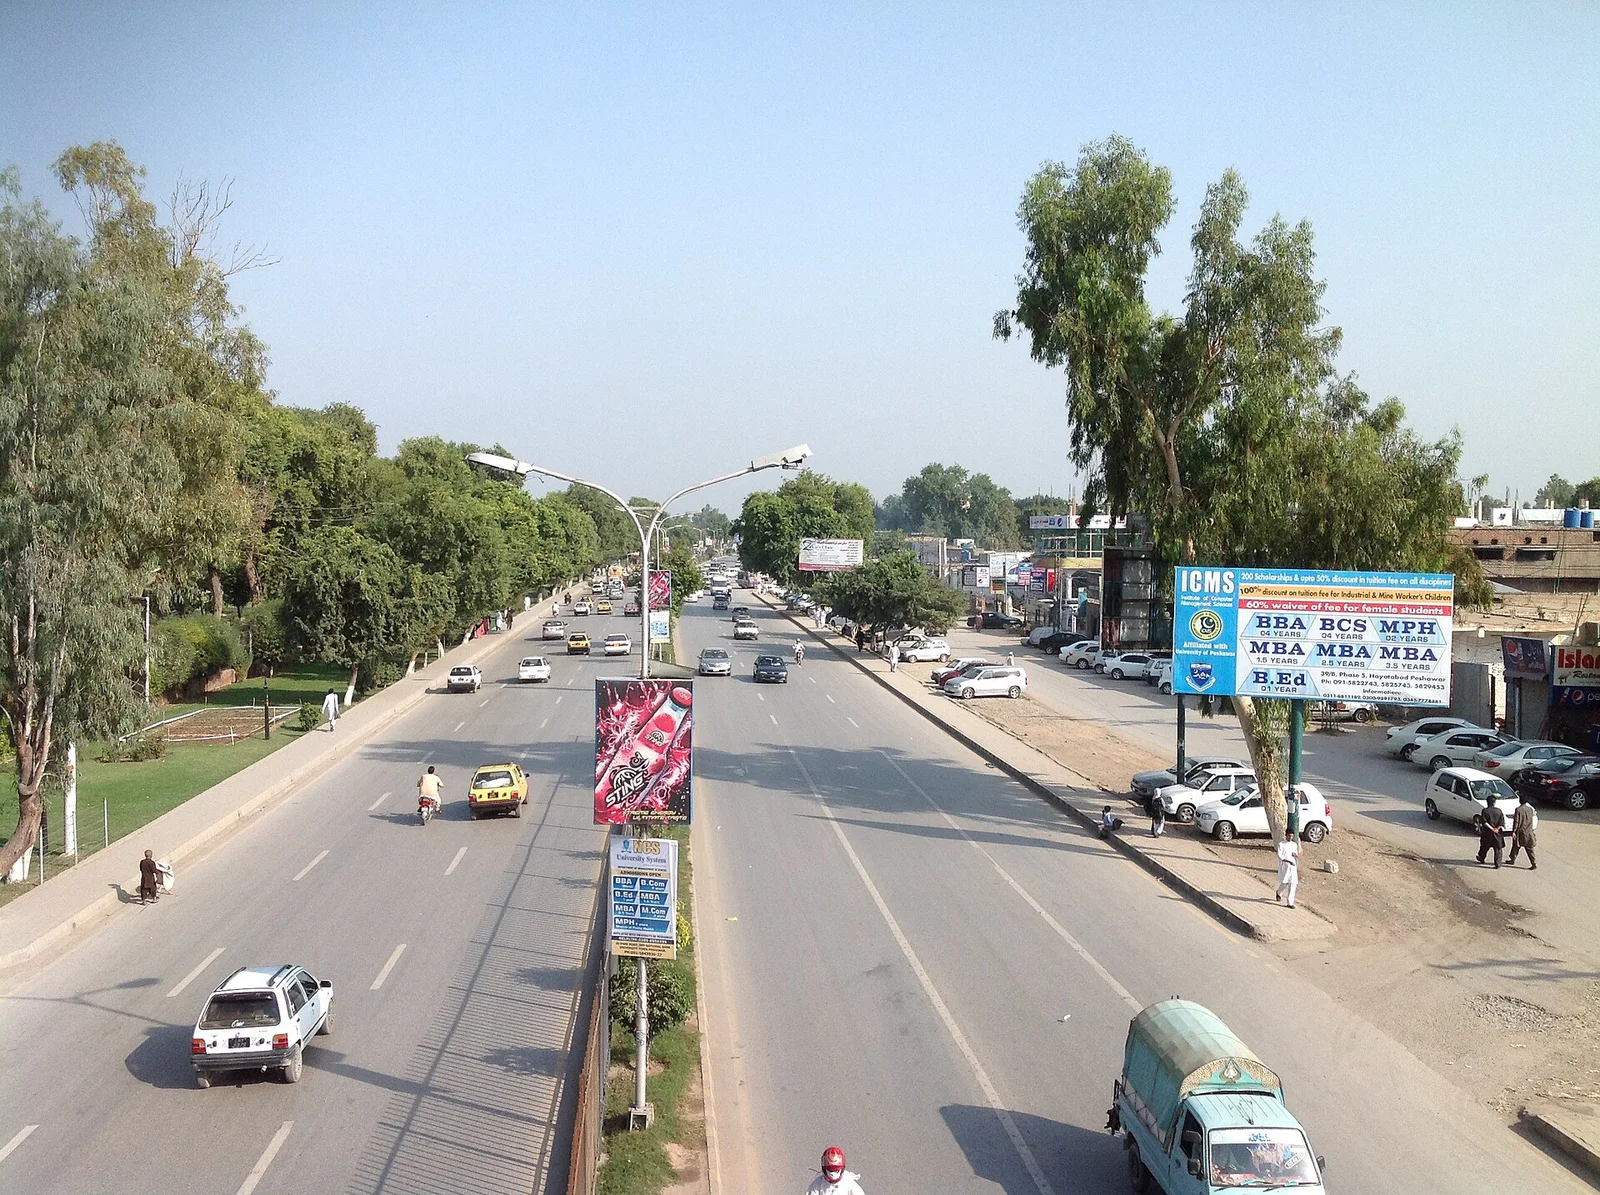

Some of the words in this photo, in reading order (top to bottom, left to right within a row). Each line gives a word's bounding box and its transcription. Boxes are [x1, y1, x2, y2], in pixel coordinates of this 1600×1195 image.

[1181, 569, 1235, 594] ICMS
[1241, 572, 1254, 580] 200
[1254, 572, 1293, 583] Scholarships
[1331, 575, 1358, 583] discount
[1410, 577, 1418, 585] all
[1419, 578, 1451, 587] disciplines
[1240, 586, 1261, 595] 100%
[1262, 588, 1288, 596] discount
[1298, 589, 1317, 597] tuition
[1341, 590, 1370, 599] Industrial
[1378, 592, 1393, 600] Mine
[1395, 593, 1423, 601] Worker's
[1425, 593, 1451, 601] Children
[1246, 601, 1269, 609] 60%
[1272, 602, 1308, 610] waiver
[1311, 603, 1322, 611] of
[1324, 603, 1341, 611] fee
[1344, 604, 1359, 612] for
[1362, 605, 1398, 614] female
[1401, 606, 1444, 615] students
[1256, 615, 1307, 630] BBA
[1319, 617, 1367, 633] BCS
[1379, 620, 1436, 635] MPH
[1335, 633, 1363, 641] YEARS
[1399, 635, 1429, 643] YEARS
[1183, 642, 1213, 650] Affiliated
[1249, 641, 1306, 656] MBA
[1316, 643, 1372, 659] MBA
[1175, 648, 1202, 657] University
[1379, 646, 1438, 662] MBA
[1270, 657, 1299, 665] YEARS
[1336, 660, 1365, 668] YEARS
[1401, 663, 1431, 671] YEARS
[1252, 671, 1307, 686] B.Ed
[1369, 672, 1409, 680] Hayatabad
[1410, 674, 1446, 682] Peshawar
[606, 773, 645, 808] STING
[632, 840, 660, 855] NCS
[616, 854, 645, 863] University
[646, 856, 667, 864] System
[615, 877, 632, 885] BBA
[640, 879, 665, 887] B.Com
[615, 890, 633, 899] B.Ed
[640, 892, 660, 901] MBA
[615, 904, 635, 913] MBA
[641, 906, 666, 915] M.Com
[615, 918, 634, 927] MPH
